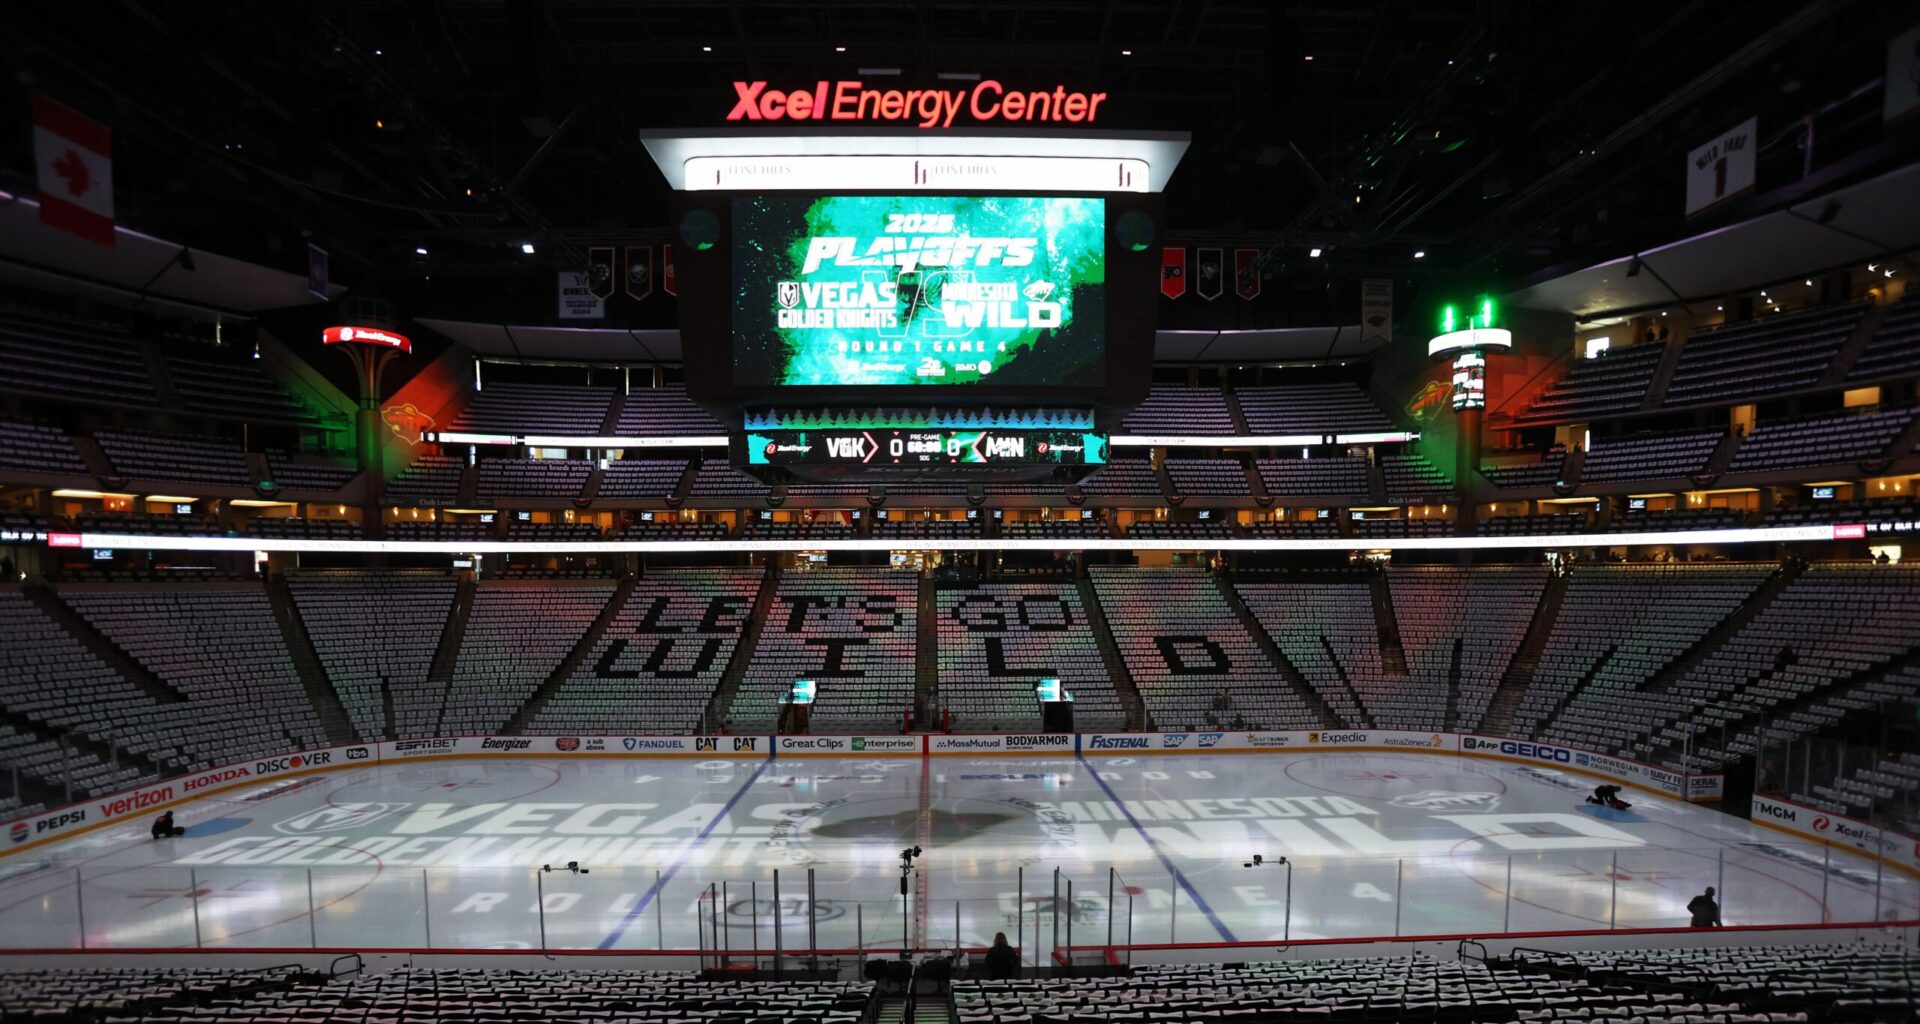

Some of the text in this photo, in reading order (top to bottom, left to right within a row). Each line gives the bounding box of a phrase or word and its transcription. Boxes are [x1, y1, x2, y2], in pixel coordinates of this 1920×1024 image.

[726, 79, 1107, 128] Xcel Energy Center
[1713, 157, 1728, 198] 1
[884, 214, 956, 233] 2025
[801, 236, 1038, 275] PLAYOFFS
[801, 282, 897, 309] VEGAS
[941, 283, 1018, 301] MINNESOTA
[777, 309, 897, 329] GOLDEN KNIGHTS
[941, 302, 1062, 328] WILD
[838, 341, 1006, 352] ROUND 1 GAME 4
[955, 363, 977, 371] BMO
[826, 437, 865, 458] VGK
[890, 438, 903, 457] 0
[947, 438, 960, 457] 0
[419, 498, 456, 506] Club Level
[952, 594, 1076, 634] GO
[395, 738, 459, 752] ESPN BET
[480, 737, 532, 753] Energizer
[592, 738, 604, 746] sub
[638, 739, 685, 749] FANDUEL
[695, 737, 719, 752] CAT
[733, 737, 757, 752] CAT
[781, 738, 844, 750] Great Clips
[854, 738, 914, 750] enterprise
[947, 738, 1001, 748] MassMutual
[1004, 736, 1069, 747] BODYARMOR
[1089, 736, 1149, 748] FASTENAL
[1163, 735, 1183, 746] SAP
[1198, 735, 1217, 746] SAP
[1320, 733, 1367, 744] Expedia
[1383, 737, 1432, 748] AstraZeneca
[347, 748, 368, 759] tbs
[403, 747, 453, 757] SPORTSBOOK
[1499, 741, 1570, 763] GEICO
[256, 751, 332, 776] DISCOVER
[1590, 755, 1639, 774] NORWEGIAN
[183, 766, 252, 793] HONDA
[1649, 769, 1672, 782] NAVY
[99, 786, 175, 818] verizon
[1033, 796, 1380, 823] MINNESOTA
[36, 809, 87, 834] PEPSI
[390, 802, 824, 836] VEGAS
[1038, 812, 1648, 859] WILD
[1834, 823, 1899, 851] Xcel Energy
[172, 836, 523, 866] GOLDEN
